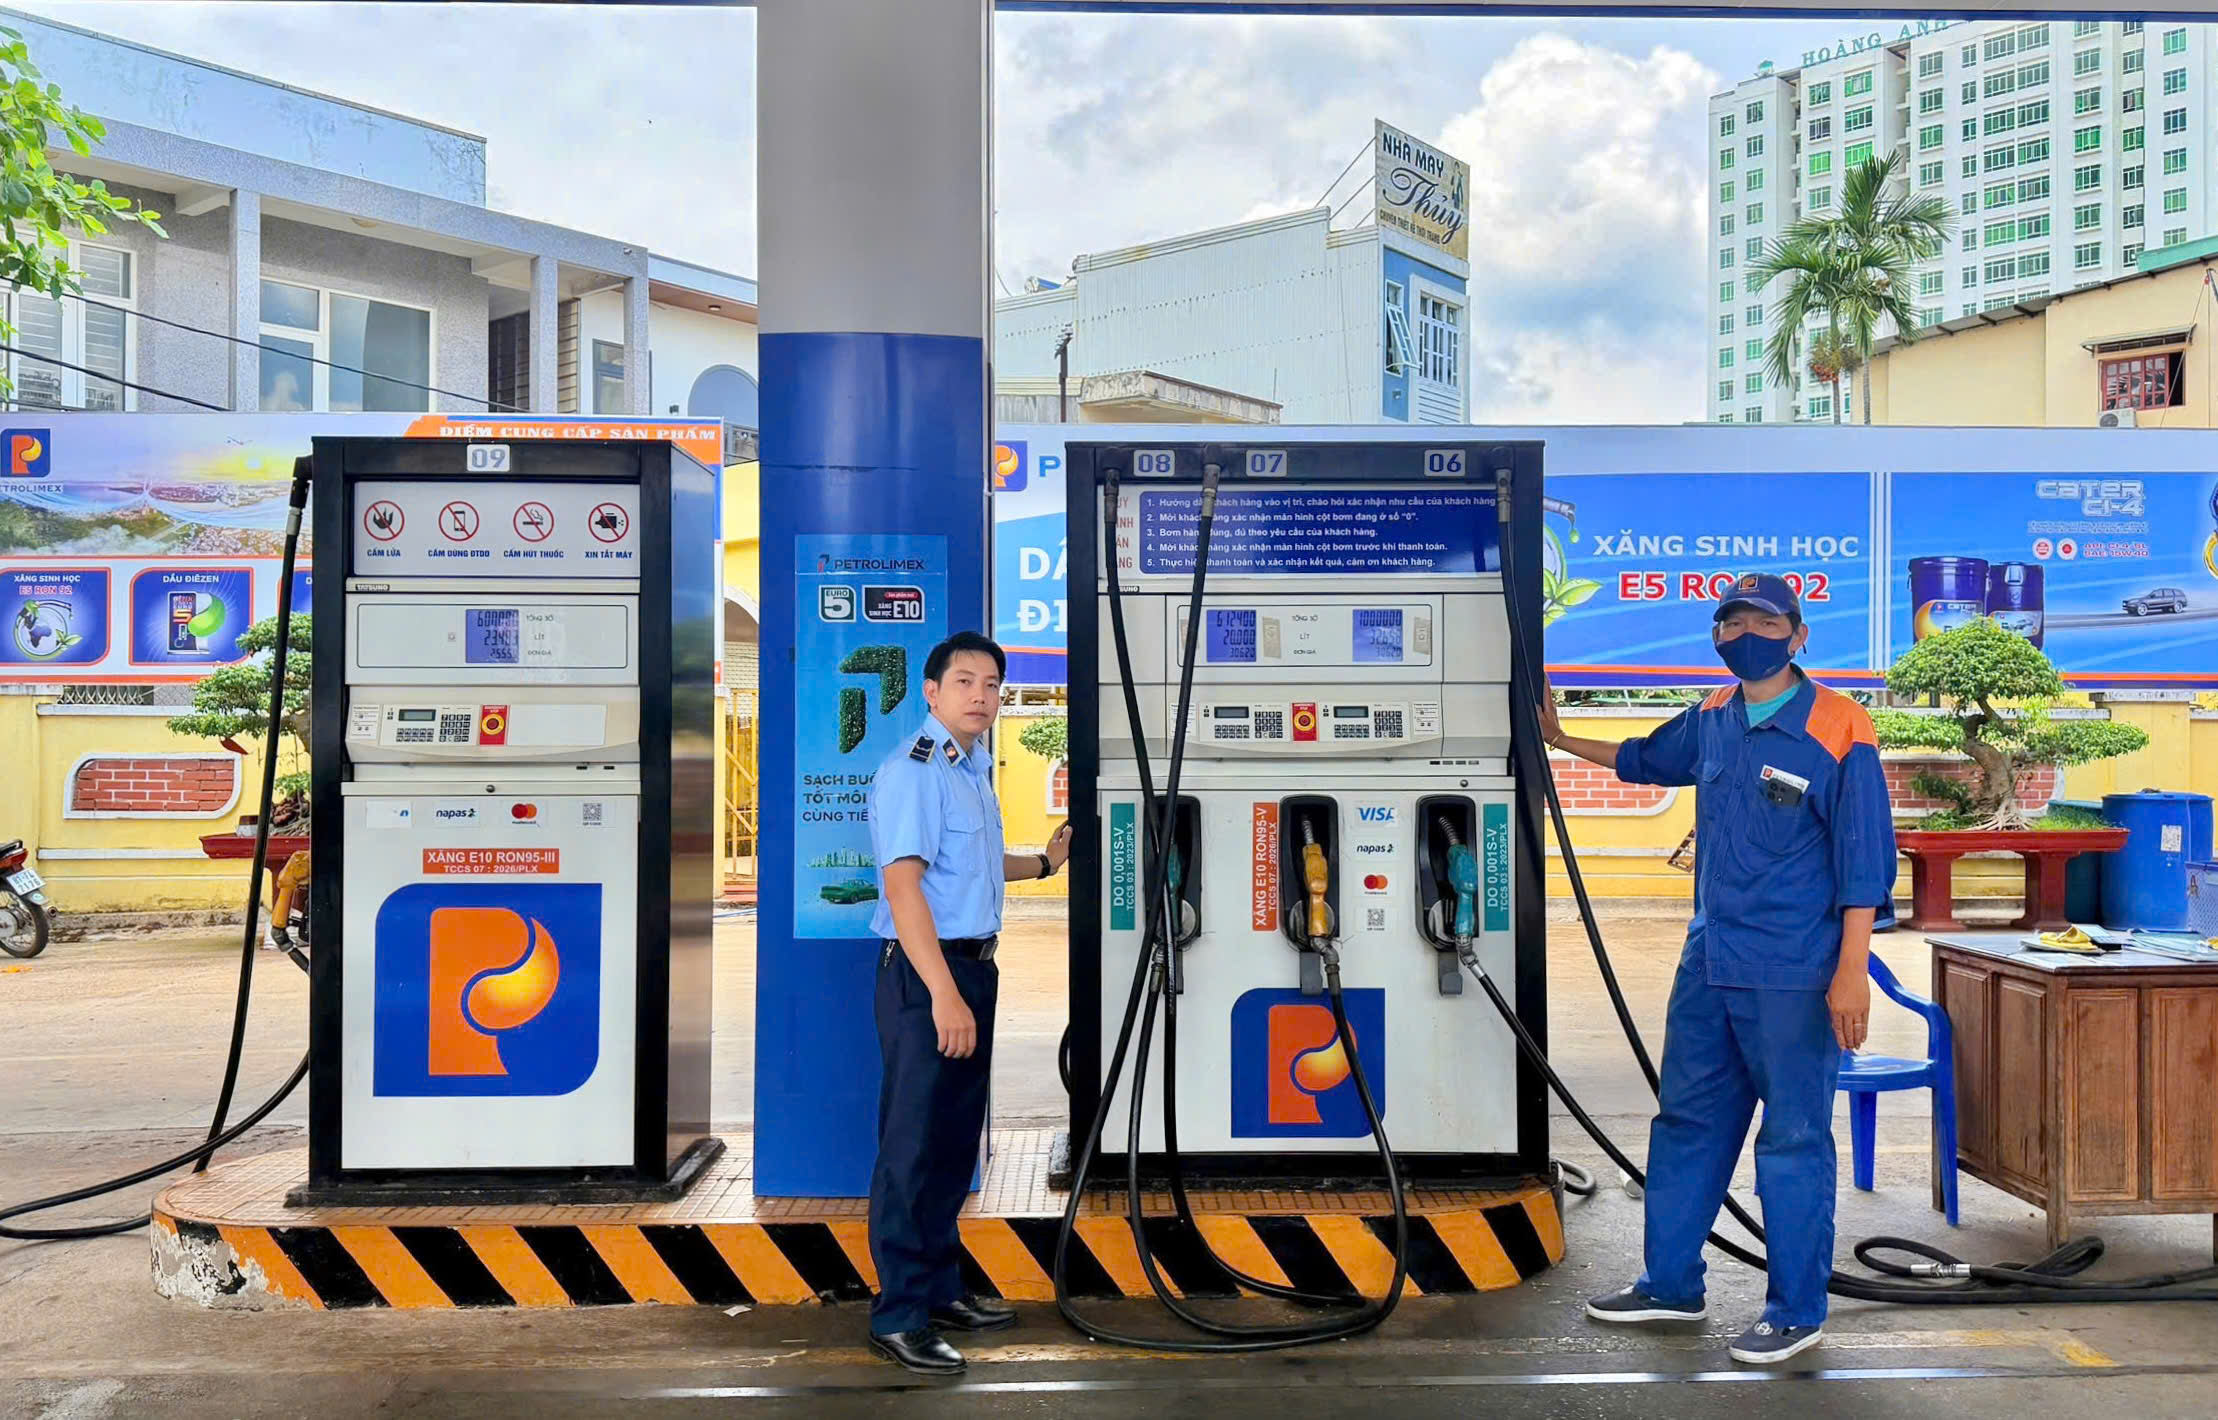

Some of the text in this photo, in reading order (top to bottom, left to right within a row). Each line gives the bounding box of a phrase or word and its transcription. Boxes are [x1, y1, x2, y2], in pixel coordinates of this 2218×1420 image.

[1801, 32, 1882, 68] HOÀNG
[1382, 132, 1444, 178] NHÀ MAY
[500, 427, 555, 438] CUNG
[471, 448, 507, 468] 09
[1138, 454, 1171, 473] 08
[1250, 454, 1283, 473] 07
[1427, 454, 1462, 473] 06
[1215, 498, 1238, 507] hách
[1240, 498, 1262, 509] hàng
[1444, 496, 1472, 505] khách
[1179, 512, 1202, 521] khác
[1213, 513, 1230, 523] àng
[1232, 512, 1248, 521] xác
[1249, 512, 1271, 523] nhận
[1183, 528, 1199, 537] hàn
[1324, 527, 1351, 536] khách
[1179, 543, 1198, 551] khác
[1232, 542, 1248, 551] xác
[1249, 543, 1271, 553] nhận
[1398, 542, 1423, 551] thanh
[1593, 529, 1859, 562] XĂNG SINH HỌC
[835, 559, 925, 569] PETROLIMEX
[1267, 557, 1283, 566] xác
[1285, 558, 1308, 568] nhận
[1382, 557, 1409, 566] khách
[14, 573, 38, 583] XĂNG
[62, 575, 81, 584] HỌC
[19, 585, 73, 595] E5 RON 92
[1619, 572, 1667, 601] E5
[1680, 572, 1735, 601] RO
[824, 597, 851, 618] 5
[893, 600, 920, 618] E10
[803, 775, 844, 788] SẠCH
[803, 788, 866, 804] TỐT MÔI
[436, 808, 467, 820] napas
[802, 807, 868, 822] CÙNG TIẾ
[427, 850, 556, 864] XĂNG E10 RON95-III
[1357, 844, 1386, 855] napas
[444, 865, 538, 873] TCCS 07 2026/PLX
[1253, 807, 1267, 926] XĂNG E10 RON95-V
[1269, 822, 1277, 911] TCCS 07 2026/PLX
[1499, 823, 1508, 912] TCCS 03 2023/PLX
[1127, 872, 1134, 882] 03
[1113, 886, 1124, 907] DO
[1487, 887, 1498, 907] DO
